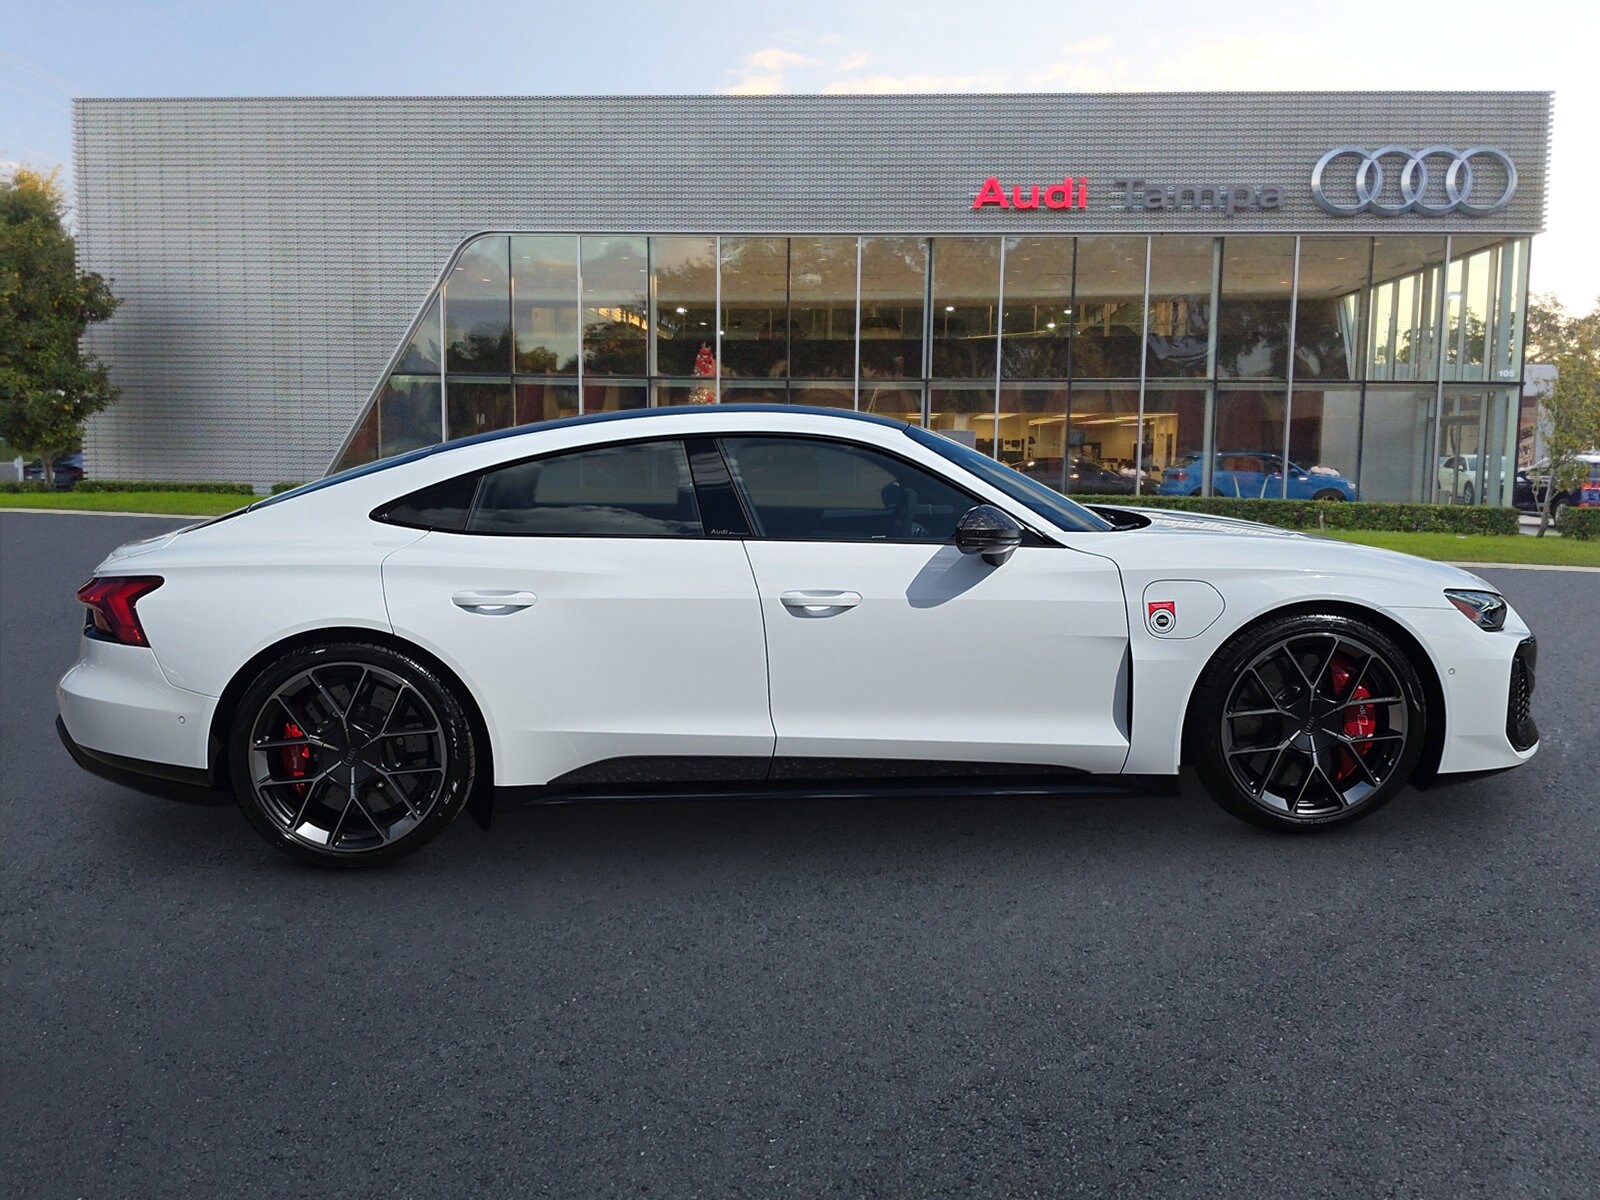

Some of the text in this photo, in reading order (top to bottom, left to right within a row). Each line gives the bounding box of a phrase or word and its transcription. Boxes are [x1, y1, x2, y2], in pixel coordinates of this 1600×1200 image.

[973, 176, 1285, 218] Audi Tampa
[1498, 369, 1515, 378] 105
[710, 528, 729, 536] Audi
